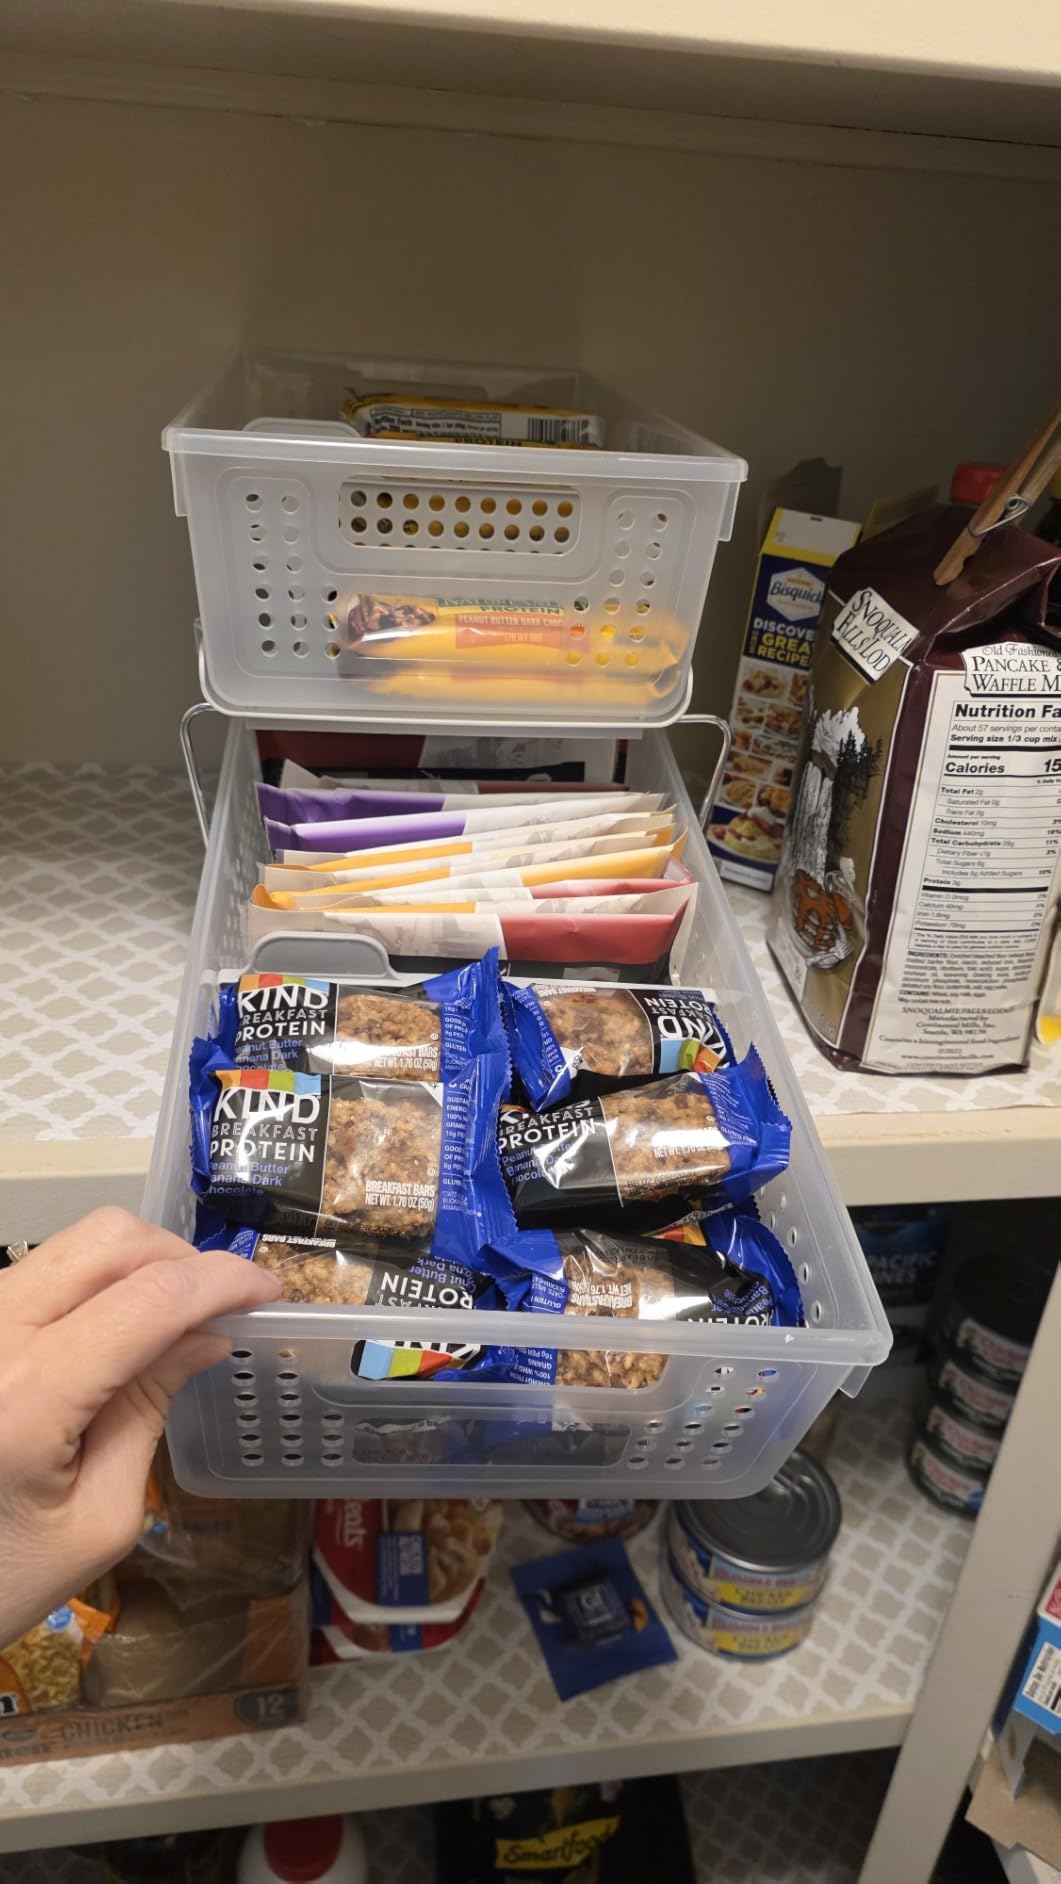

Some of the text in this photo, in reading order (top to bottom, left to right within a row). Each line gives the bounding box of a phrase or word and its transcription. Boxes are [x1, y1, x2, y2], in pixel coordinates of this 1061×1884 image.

[458, 615, 488, 625] PEANUT
[490, 615, 518, 626] BUTTER
[753, 617, 815, 641] DISCOVE
[852, 591, 914, 653] SNOQUALM
[762, 632, 814, 655] GREA
[982, 644, 1003, 656] Old
[757, 645, 811, 667] RECIPE
[859, 638, 891, 672] LOD
[972, 655, 1051, 672] PANCAKE
[971, 673, 1061, 691] WAFFLE M
[955, 703, 1061, 718] Nutrition Fa
[952, 724, 1061, 734] About 57 servings per conta
[950, 734, 984, 743] Serving
[1024, 736, 1040, 744] cup
[1042, 735, 1057, 743] mix
[945, 758, 1061, 774] Calories 15
[941, 786, 960, 794] Total
[934, 817, 979, 826] Cholesterol
[936, 848, 960, 857] Dietary
[923, 877, 951, 885] Protein
[237, 984, 329, 1014] KIND
[241, 1008, 328, 1026] REAKFAST
[269, 1039, 304, 1050] Butter
[272, 1049, 299, 1060] Dark
[213, 1087, 320, 1124] KIND
[210, 1138, 316, 1163] PROTEIN
[250, 1161, 289, 1174] Butter
[210, 1173, 282, 1187] anana Dark
[365, 1180, 436, 1198] BREAKFAST BARS
[365, 1192, 379, 1207] NET
[408, 1196, 417, 1209] OZ
[261, 1233, 337, 1248] BREAKFAST BARS
[409, 1265, 447, 1284] Butter
[381, 1271, 473, 1310] ROTEIN
[256, 1695, 285, 1716] 12
[60, 1711, 163, 1741] CHICKEN
